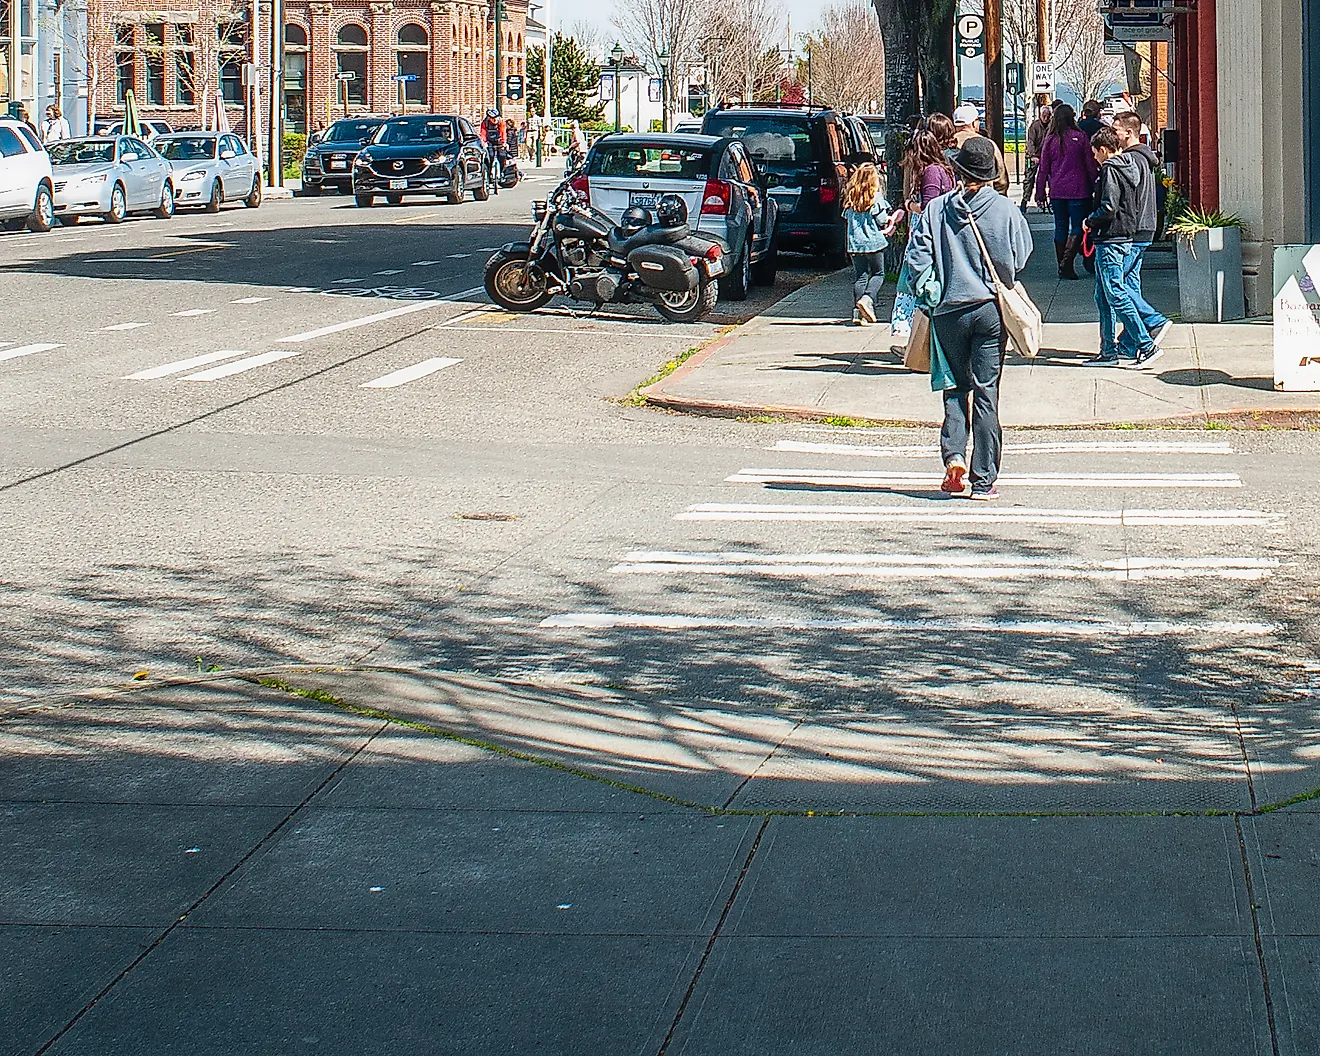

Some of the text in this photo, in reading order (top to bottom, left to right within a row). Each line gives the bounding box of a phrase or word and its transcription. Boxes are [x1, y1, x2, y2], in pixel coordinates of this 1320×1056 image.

[966, 21, 978, 33] P
[1145, 27, 1164, 35] grace
[1035, 65, 1052, 73] ONE
